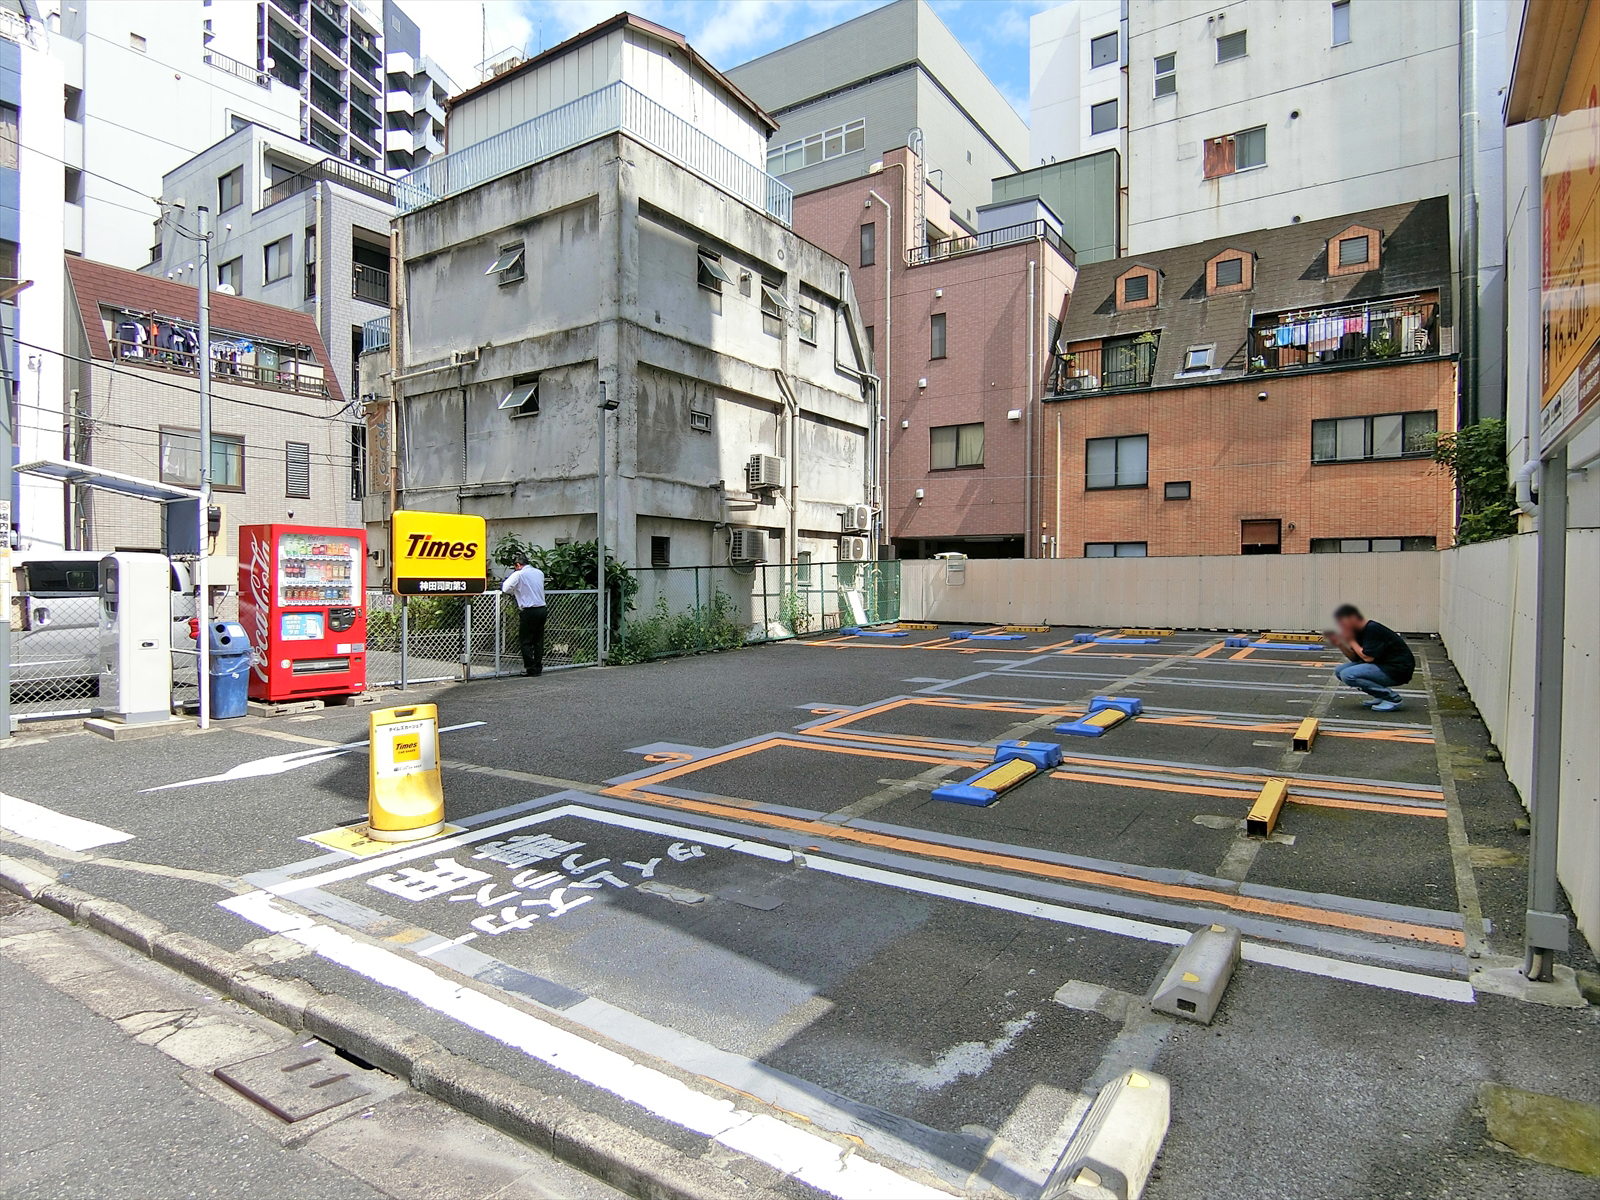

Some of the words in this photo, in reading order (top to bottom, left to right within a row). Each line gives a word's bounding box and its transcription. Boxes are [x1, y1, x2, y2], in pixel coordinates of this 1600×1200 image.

[405, 533, 478, 560] Times
[419, 580, 467, 592] 神田司町第3
[389, 723, 423, 732] タイムズカーシェア
[396, 742, 418, 750] Times
[366, 833, 585, 901] 専用
